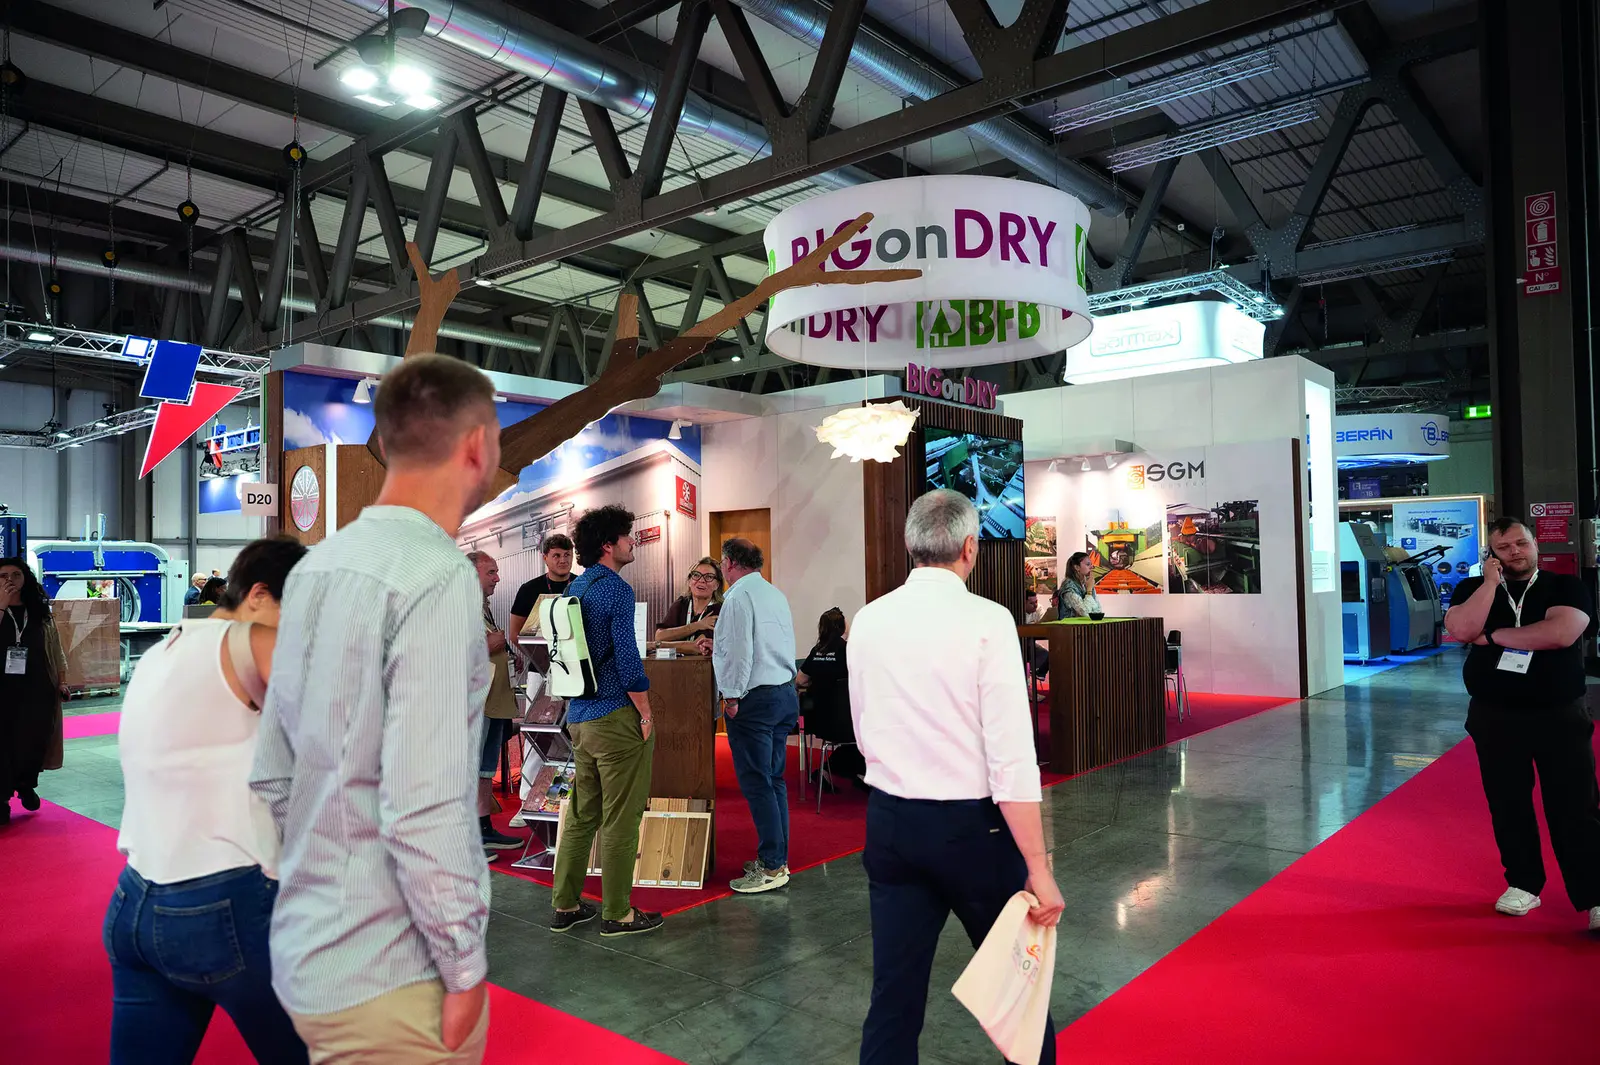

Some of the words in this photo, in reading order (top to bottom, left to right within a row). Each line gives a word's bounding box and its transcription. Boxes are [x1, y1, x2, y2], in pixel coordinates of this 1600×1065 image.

[906, 362, 1000, 410] BIGonDRY
[1146, 460, 1205, 482] SGM
[247, 493, 272, 505] D20
